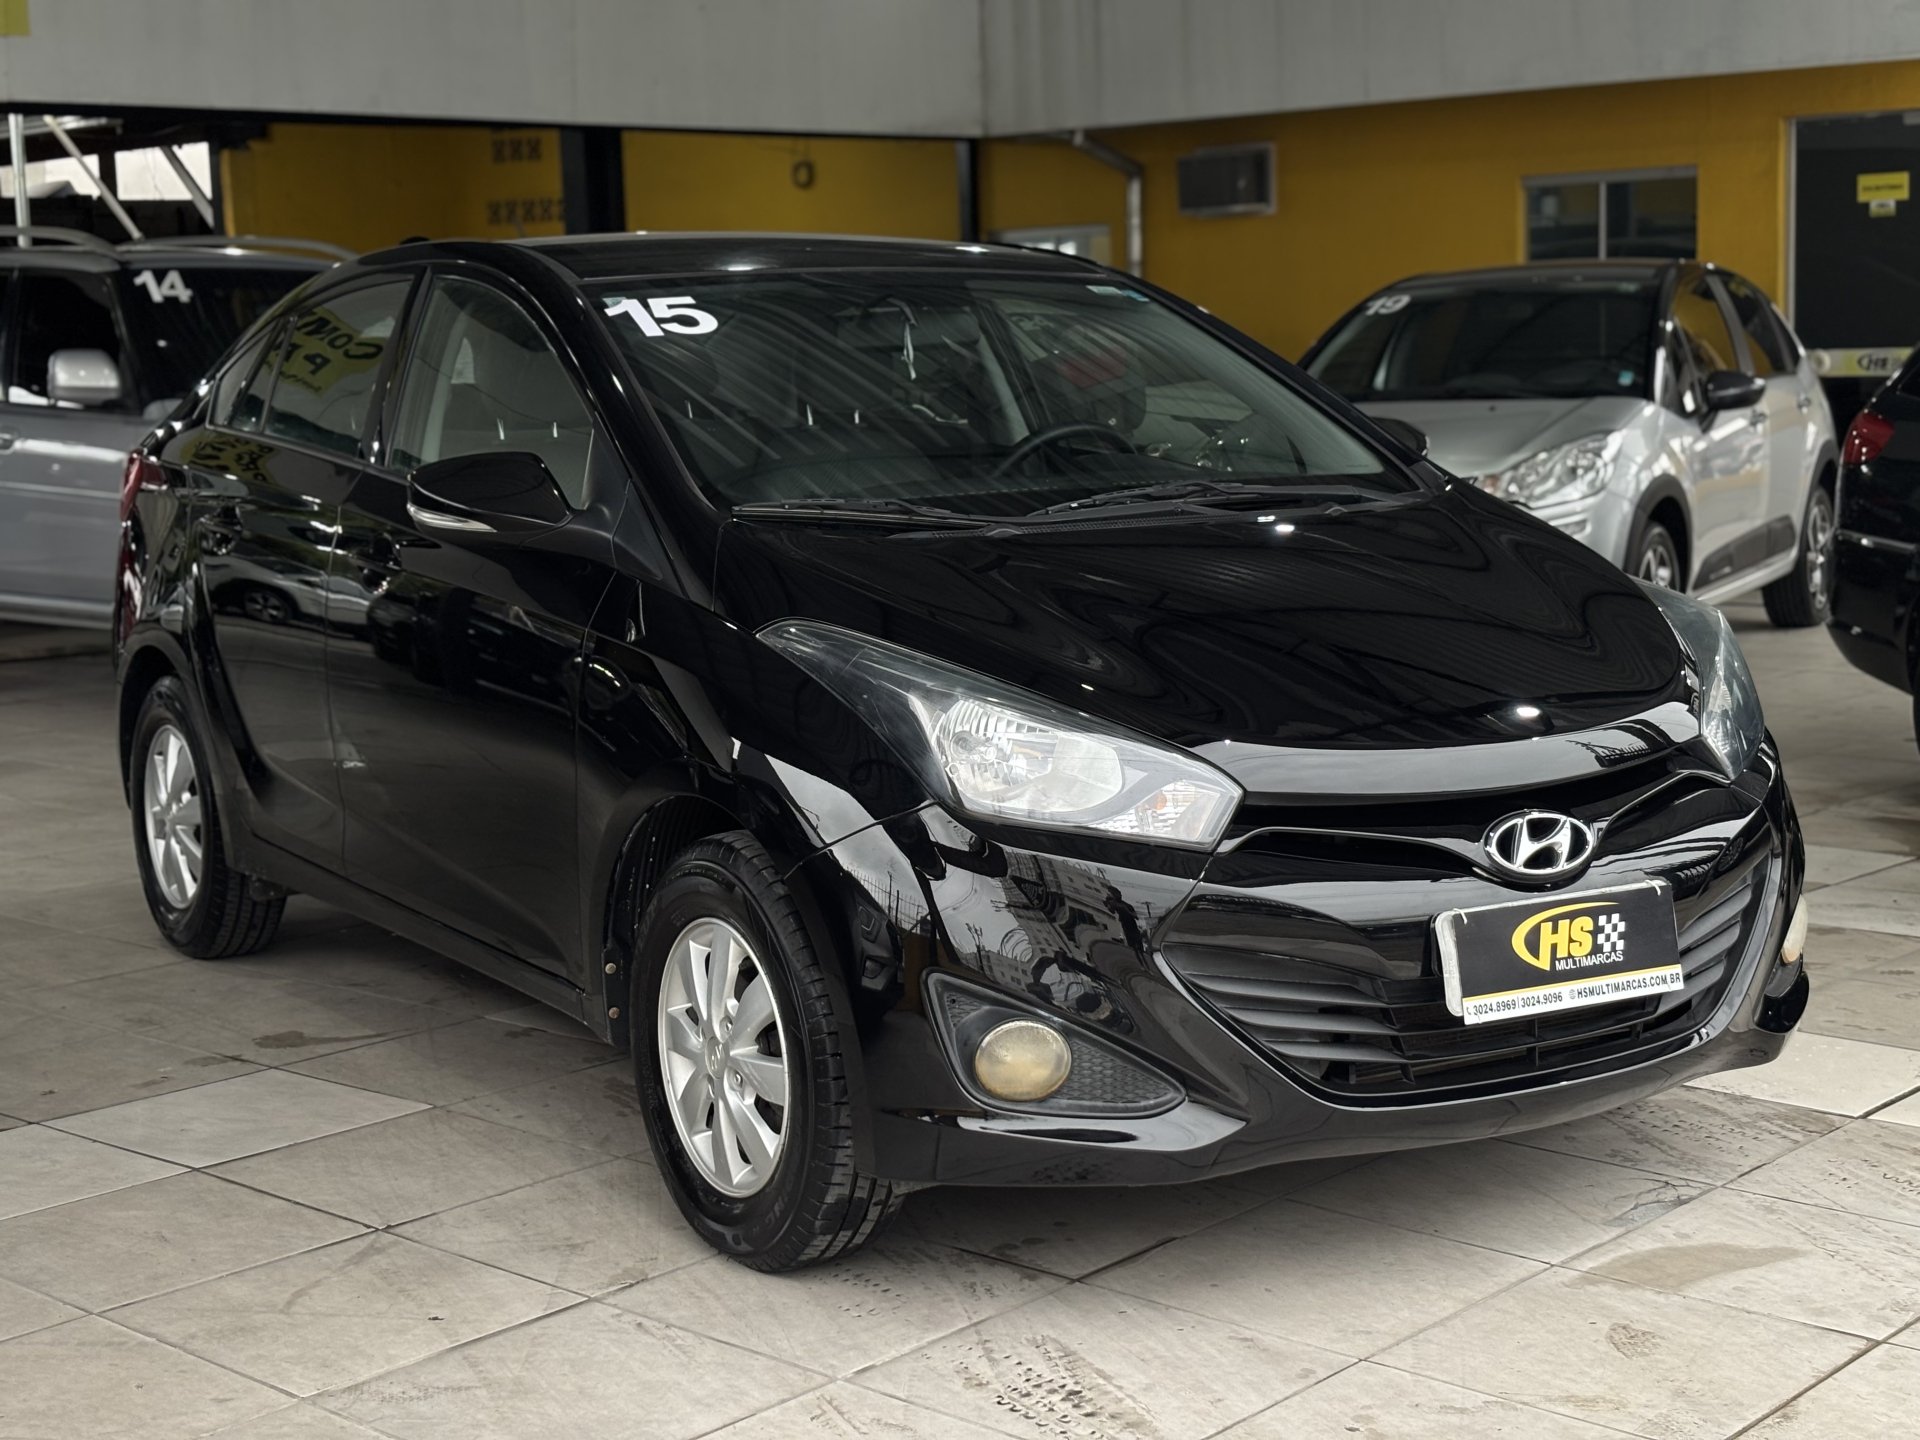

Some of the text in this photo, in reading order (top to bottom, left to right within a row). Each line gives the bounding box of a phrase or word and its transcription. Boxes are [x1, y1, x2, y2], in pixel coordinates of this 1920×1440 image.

[133, 269, 193, 303] 14
[604, 296, 718, 336] 15
[1365, 294, 1411, 316] 19
[1555, 951, 1624, 971] MULTIMARCAS
